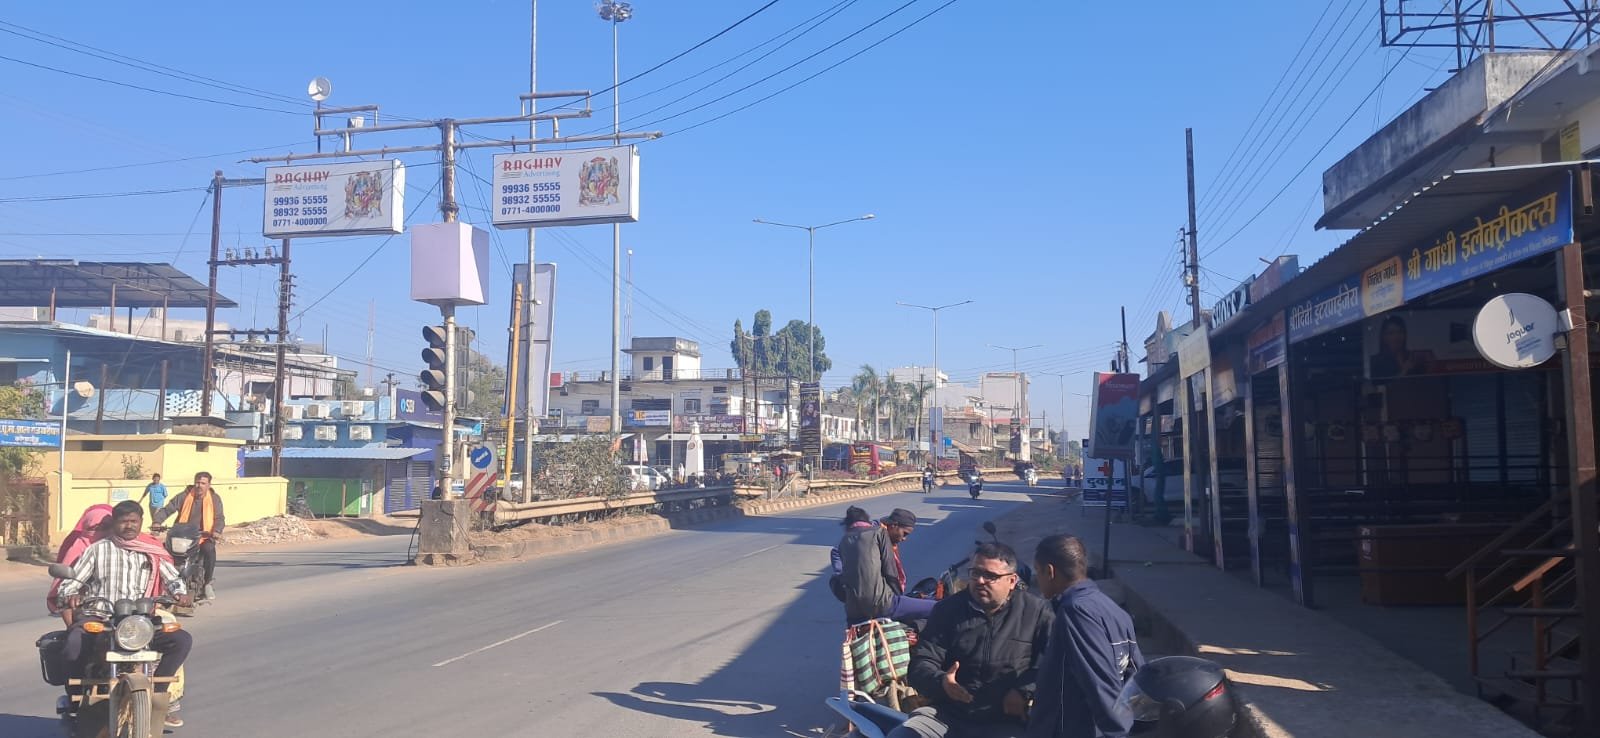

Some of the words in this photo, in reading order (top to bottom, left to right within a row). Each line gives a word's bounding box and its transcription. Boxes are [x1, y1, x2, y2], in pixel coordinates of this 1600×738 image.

[503, 157, 562, 171] RAGHAV
[275, 171, 330, 183] RAGHAV
[502, 184, 529, 193] 99936
[533, 182, 561, 192] 55555
[273, 196, 299, 206] 99936
[302, 195, 328, 205] 55555
[502, 195, 529, 205] 98932
[533, 193, 561, 203] 55555
[273, 207, 299, 217] 98932
[302, 206, 328, 216] 55555
[502, 205, 560, 215] 0771-4000000
[273, 217, 328, 227] 0771-4000000
[1407, 248, 1421, 280] श्री
[1425, 231, 1457, 272] गांधी
